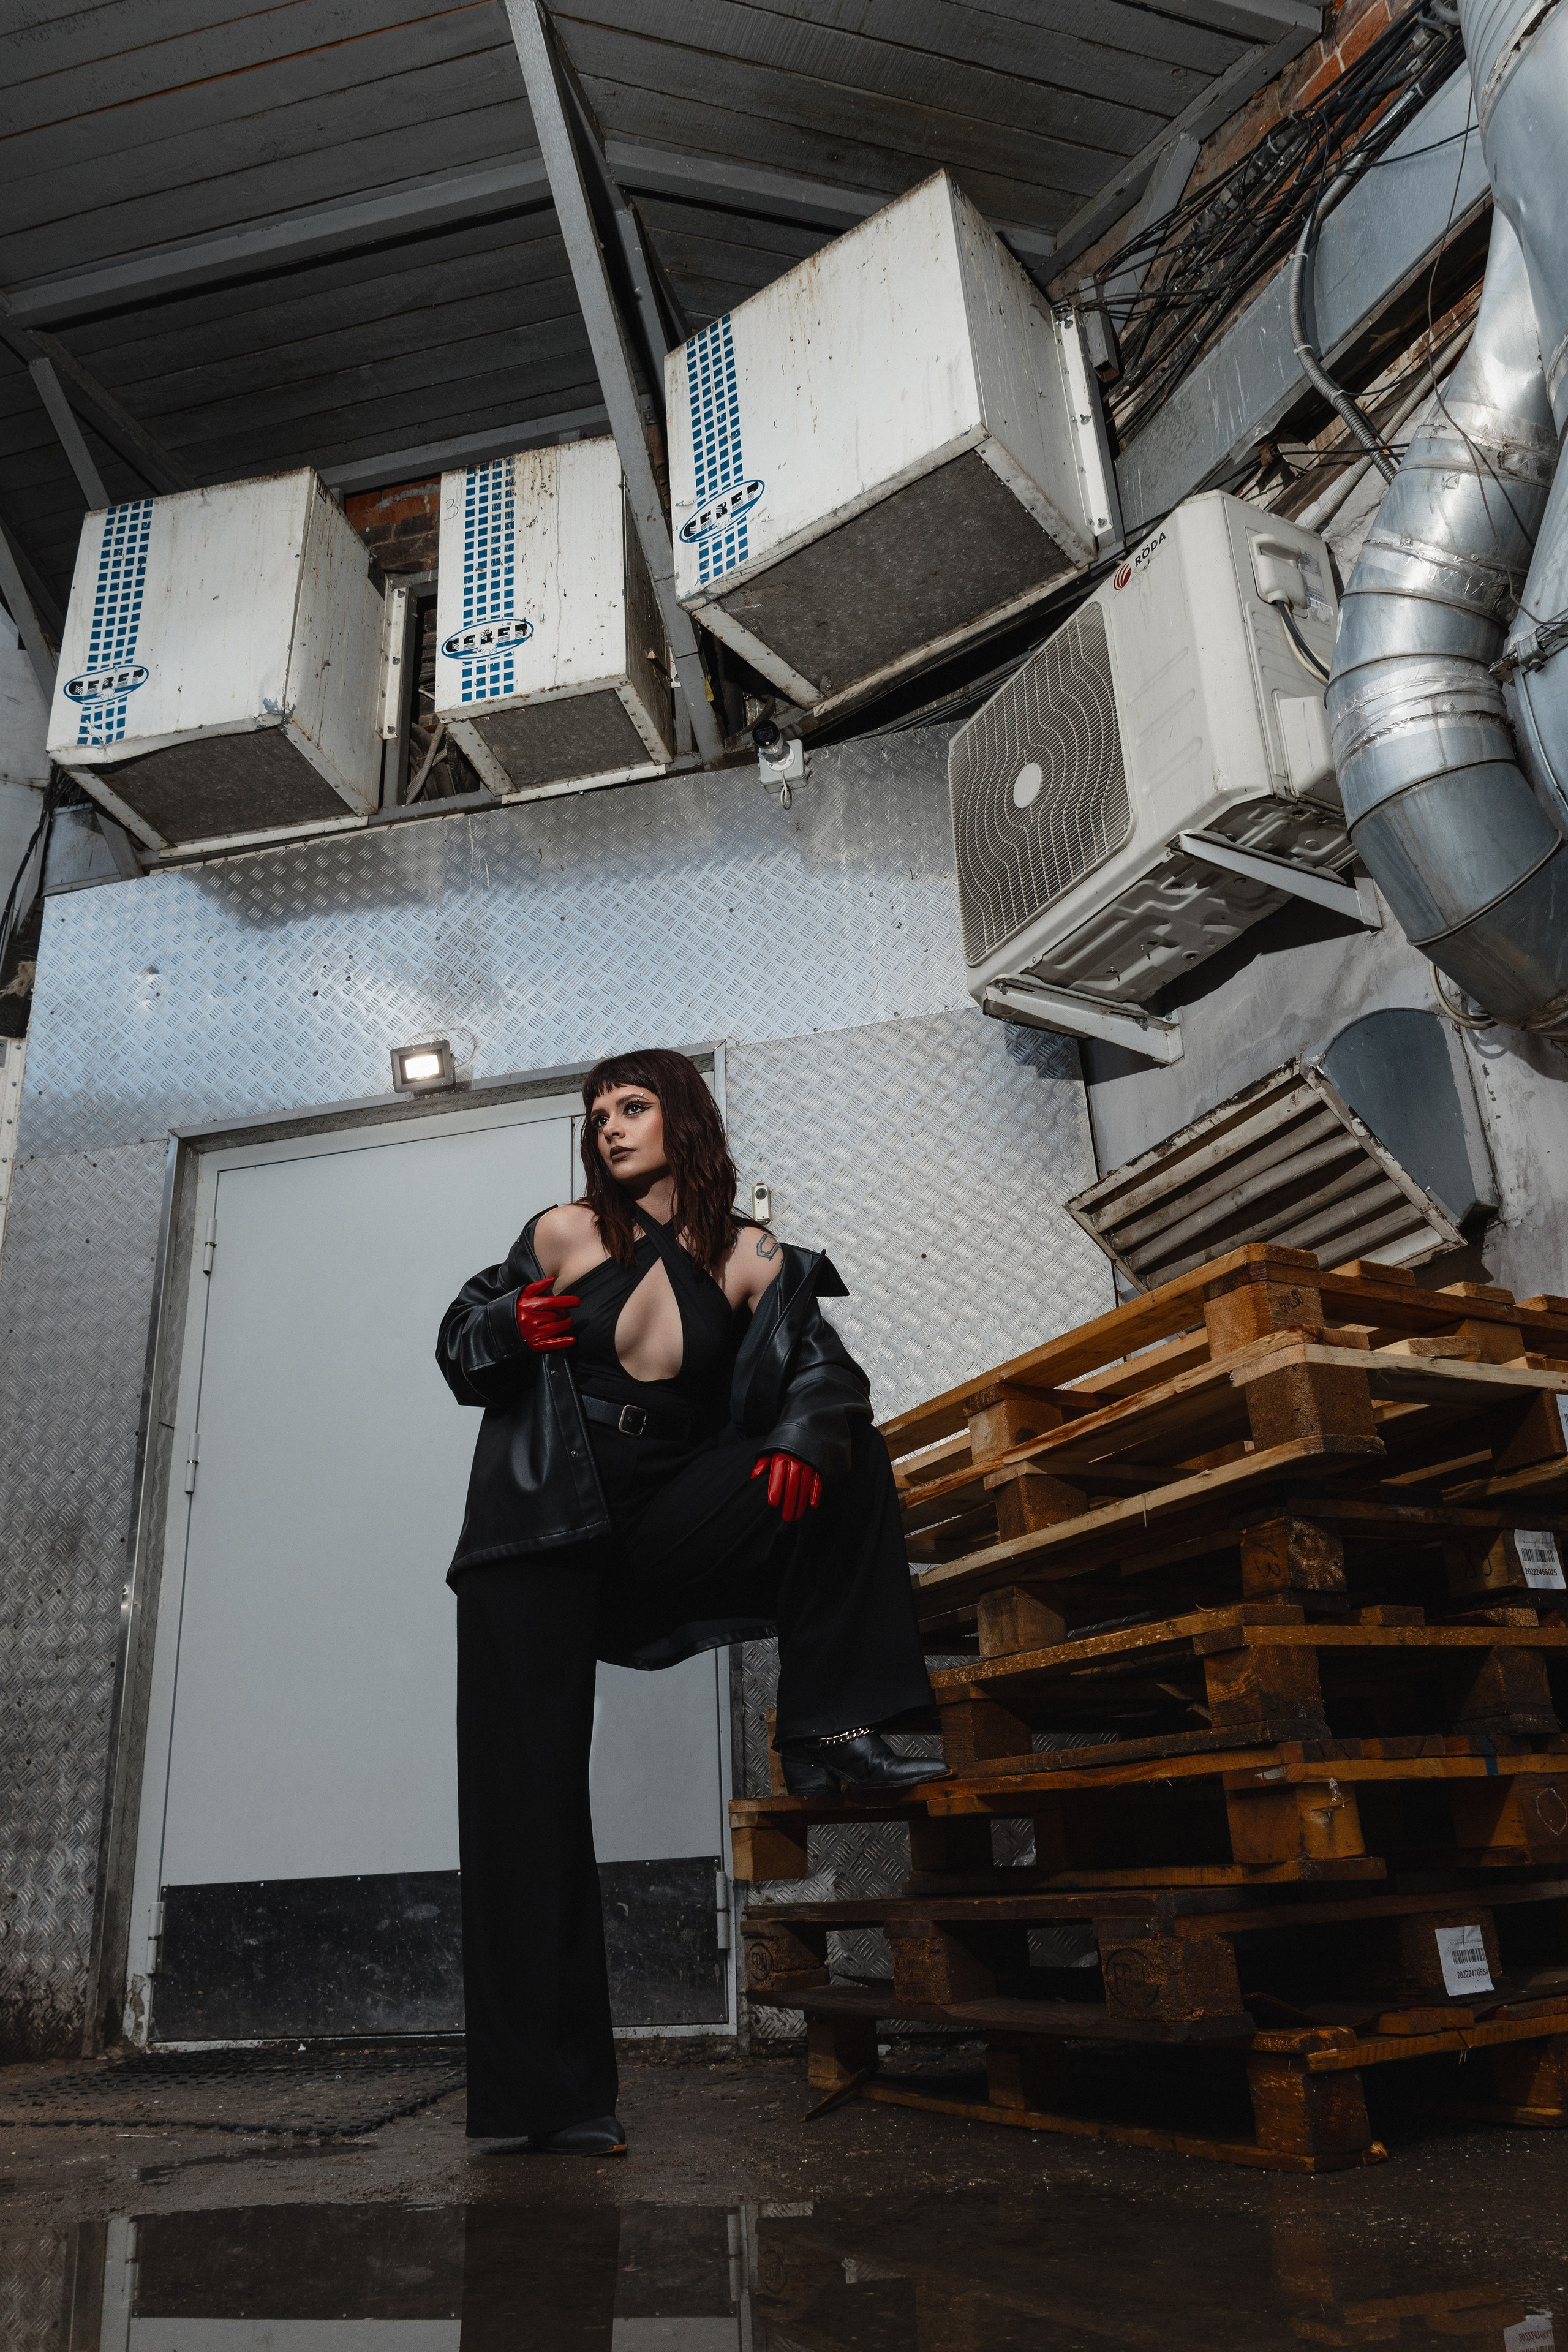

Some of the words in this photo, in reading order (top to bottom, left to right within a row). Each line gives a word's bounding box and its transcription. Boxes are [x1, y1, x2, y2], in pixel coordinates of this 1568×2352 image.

[1135, 532, 1167, 567] RÖDA
[1525, 1567, 1558, 1577] 20222468025
[1457, 1967, 1489, 1980] 20222470554
